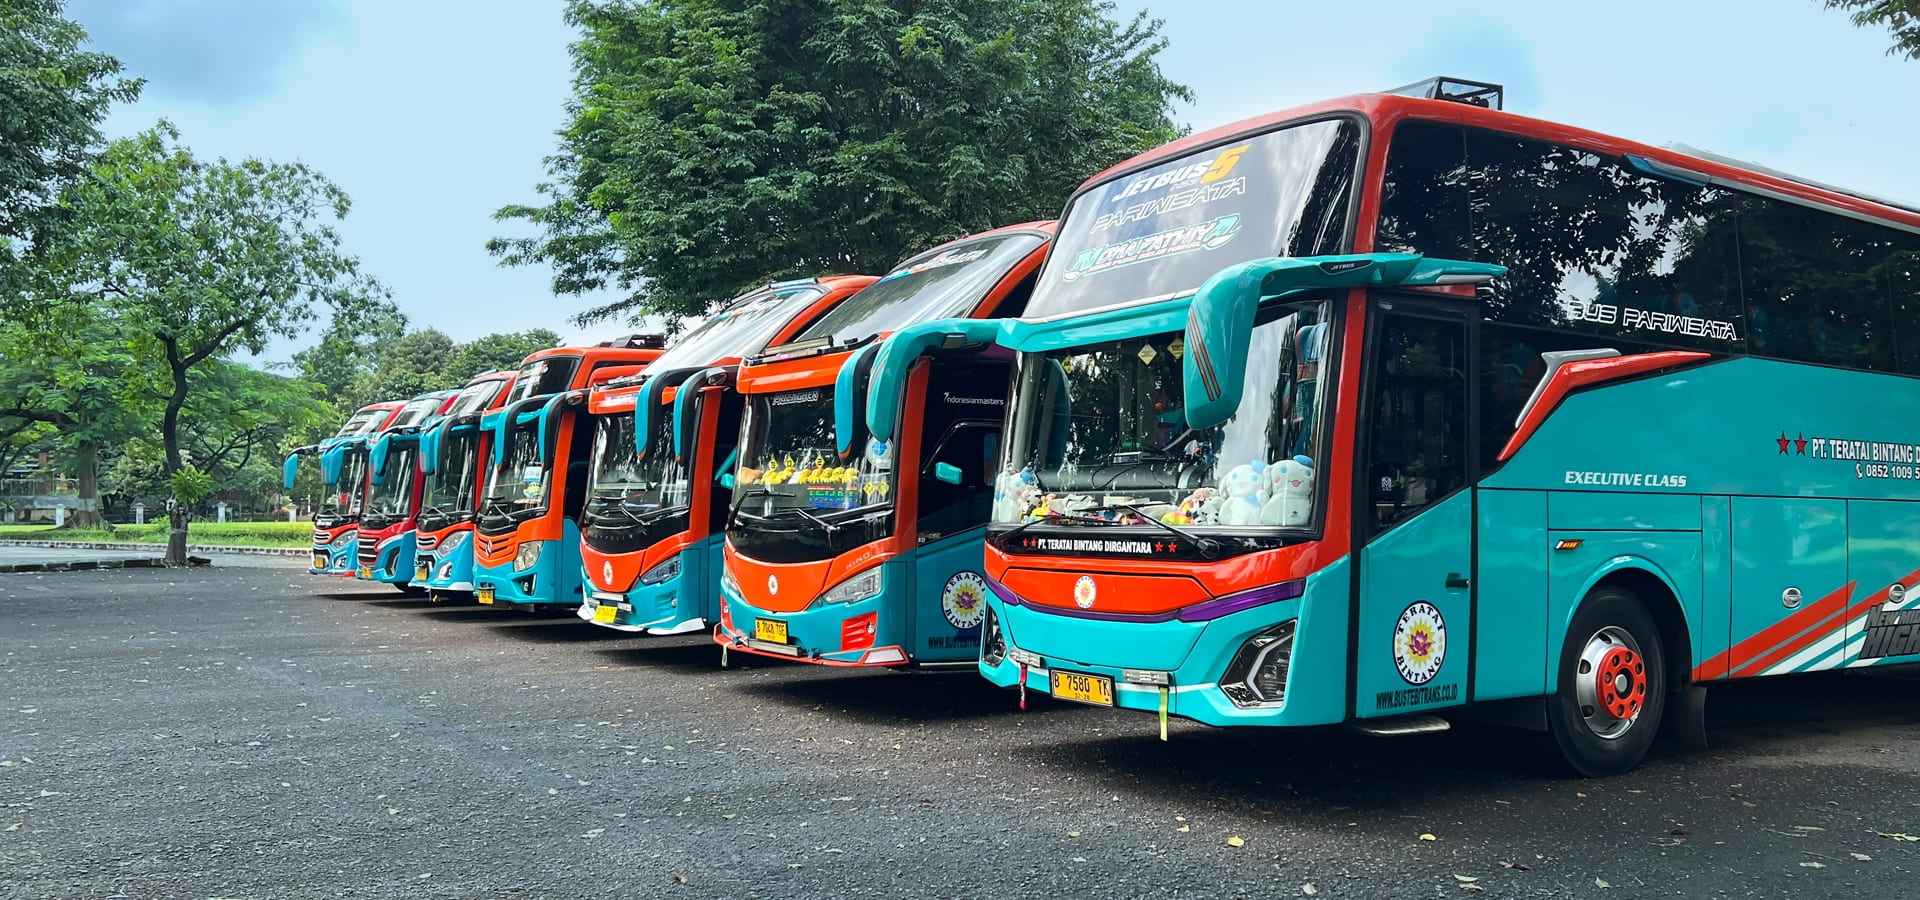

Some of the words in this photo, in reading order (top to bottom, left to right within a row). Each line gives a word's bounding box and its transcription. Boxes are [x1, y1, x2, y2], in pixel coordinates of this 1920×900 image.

[1112, 159, 1213, 202] JETBUS
[1089, 176, 1246, 235] PARIWISATA
[1566, 300, 1618, 324] BUS
[1623, 308, 1738, 341] PARIWISATA
[1811, 438, 1827, 458] PT.
[1829, 439, 1870, 461] TERATAI
[1873, 442, 1913, 464] BINTANG
[1564, 471, 1642, 486] EXECUTIVE
[1644, 474, 1688, 488] CLASS
[1866, 464, 1889, 478] 0852
[1891, 465, 1913, 479] 1009
[1048, 539, 1072, 551] TERATAI
[1073, 540, 1103, 552] BINTANG
[1104, 541, 1152, 554] DIRGANTARA
[1397, 604, 1444, 636] TERATAI
[1863, 603, 1899, 631] NEW
[1397, 656, 1441, 682] BINTANG
[1054, 673, 1060, 688] B
[1067, 675, 1090, 692] 7580
[1097, 679, 1111, 696] TK
[1376, 683, 1458, 710] WWW.BUSTEBITRANS.CO.ID
